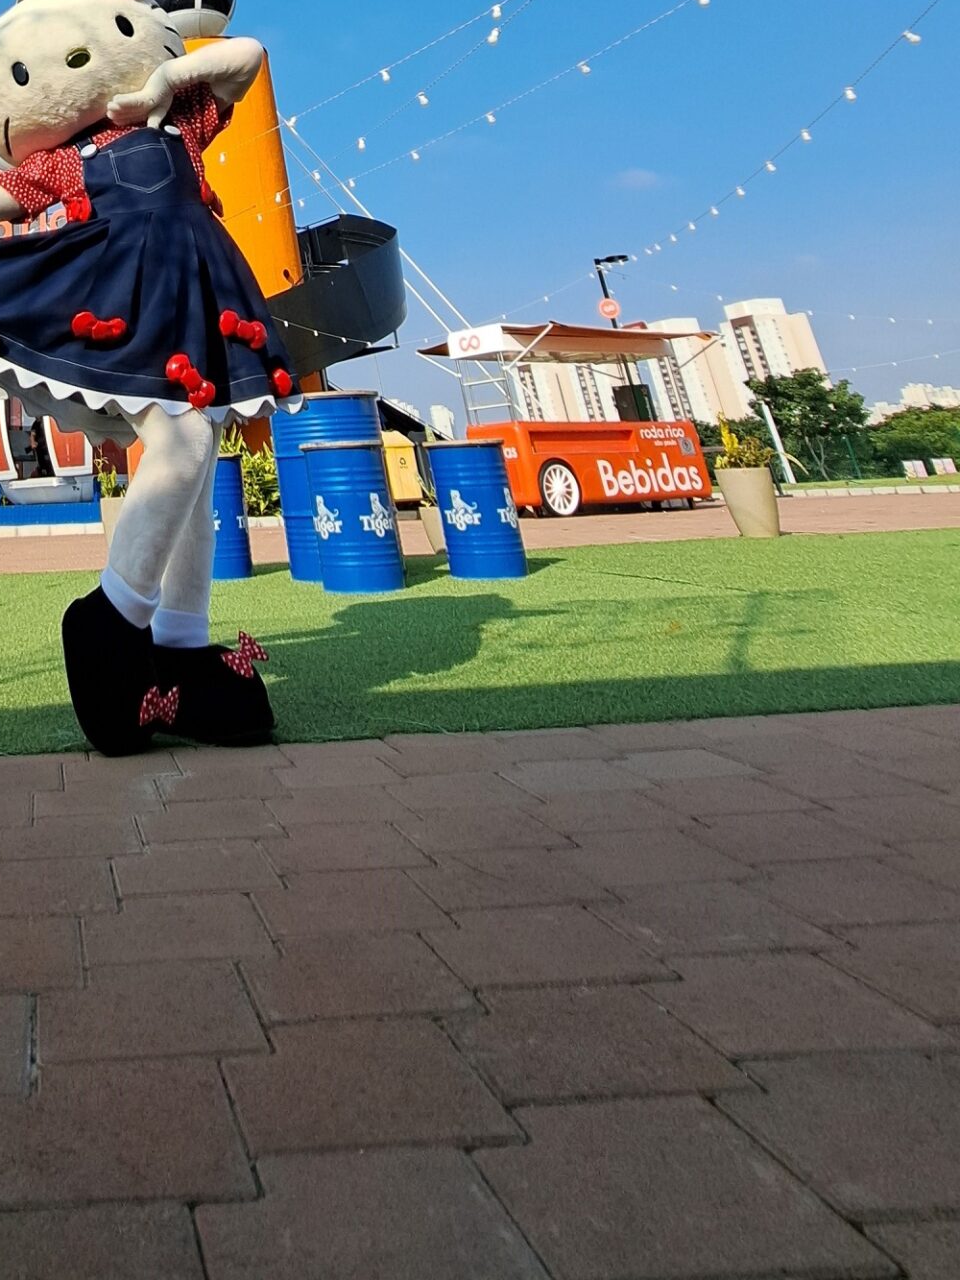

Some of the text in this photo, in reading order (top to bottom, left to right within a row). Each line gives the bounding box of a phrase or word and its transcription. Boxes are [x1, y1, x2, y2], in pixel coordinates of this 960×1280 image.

[640, 425, 685, 439] roda rico
[597, 452, 704, 497] Bebidas
[444, 508, 482, 531] Tiger
[497, 507, 519, 529] Tig
